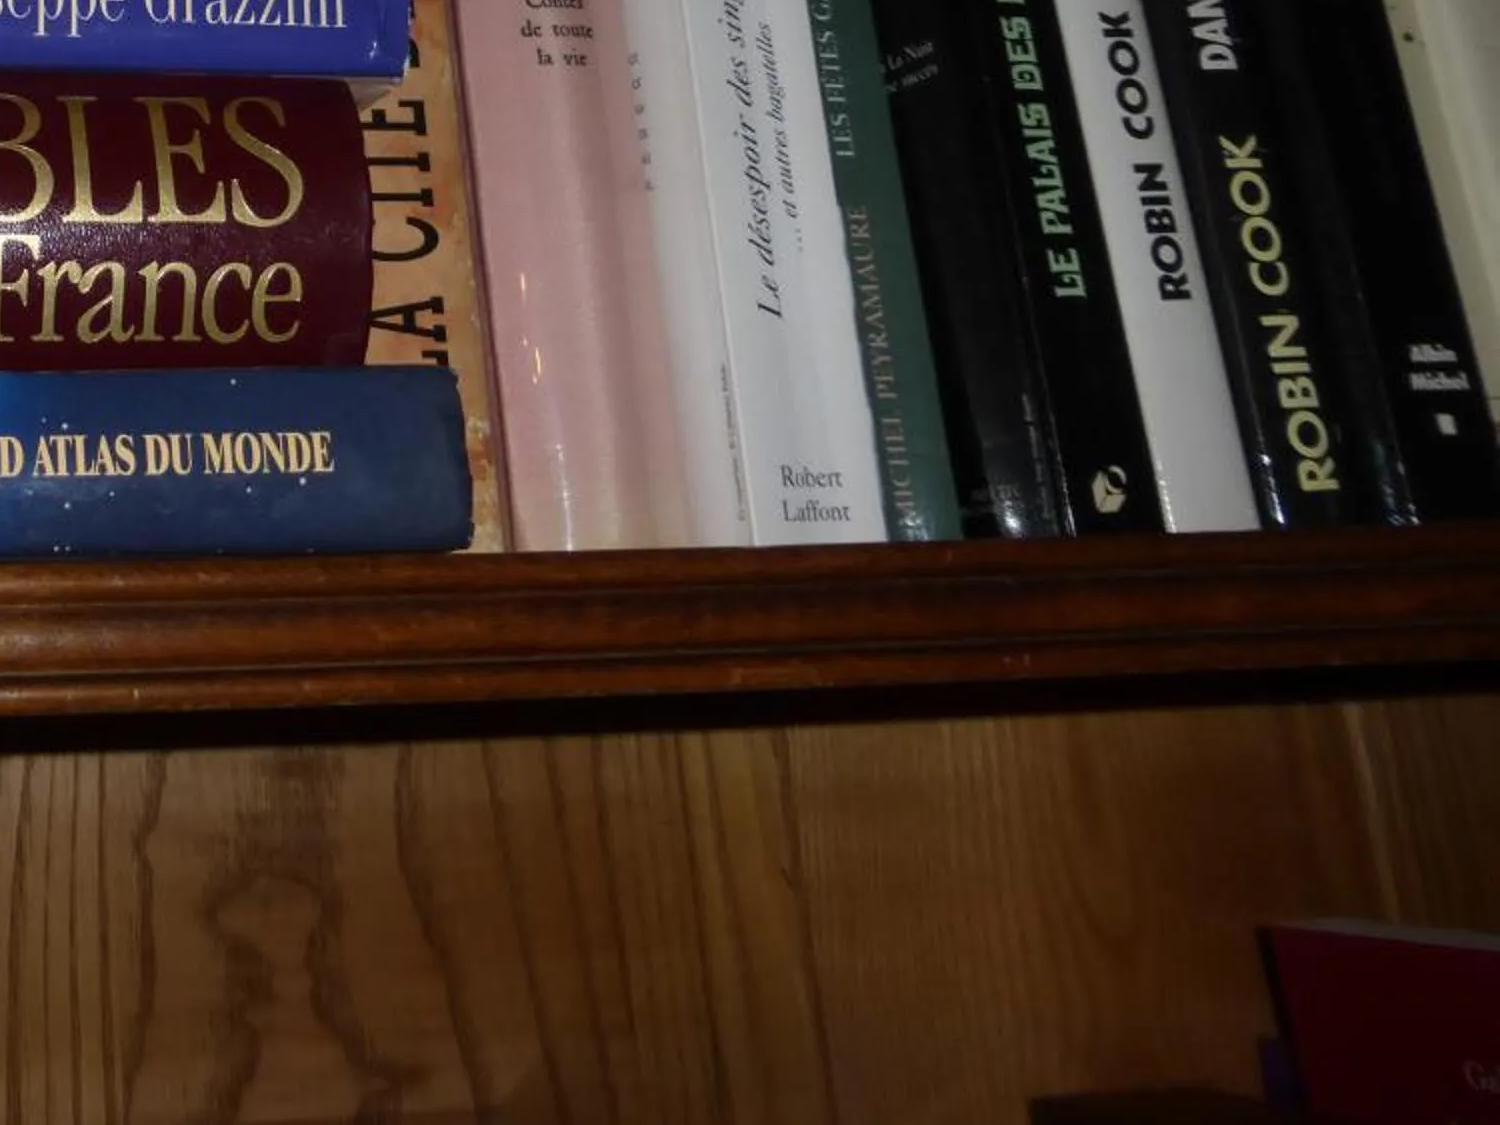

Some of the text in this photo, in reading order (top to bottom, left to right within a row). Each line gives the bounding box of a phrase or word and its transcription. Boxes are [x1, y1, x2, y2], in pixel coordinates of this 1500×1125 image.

[520, 20, 594, 39] de toute
[999, 15, 1045, 92] DES
[536, 48, 588, 66] la vie
[726, 57, 754, 108] des
[1018, 101, 1075, 236] PALAIS
[1098, 11, 1192, 302] ROBIN COOK
[736, 113, 776, 267] désespoir
[757, 275, 782, 319] Le
[1045, 245, 1088, 301] LE
[1218, 132, 1341, 493] ROBIN COOK
[33, 433, 137, 476] ATLAS
[142, 432, 193, 475] DU
[203, 431, 336, 475] MONDE
[780, 465, 843, 490] Robert
[782, 499, 852, 523] Laffont
